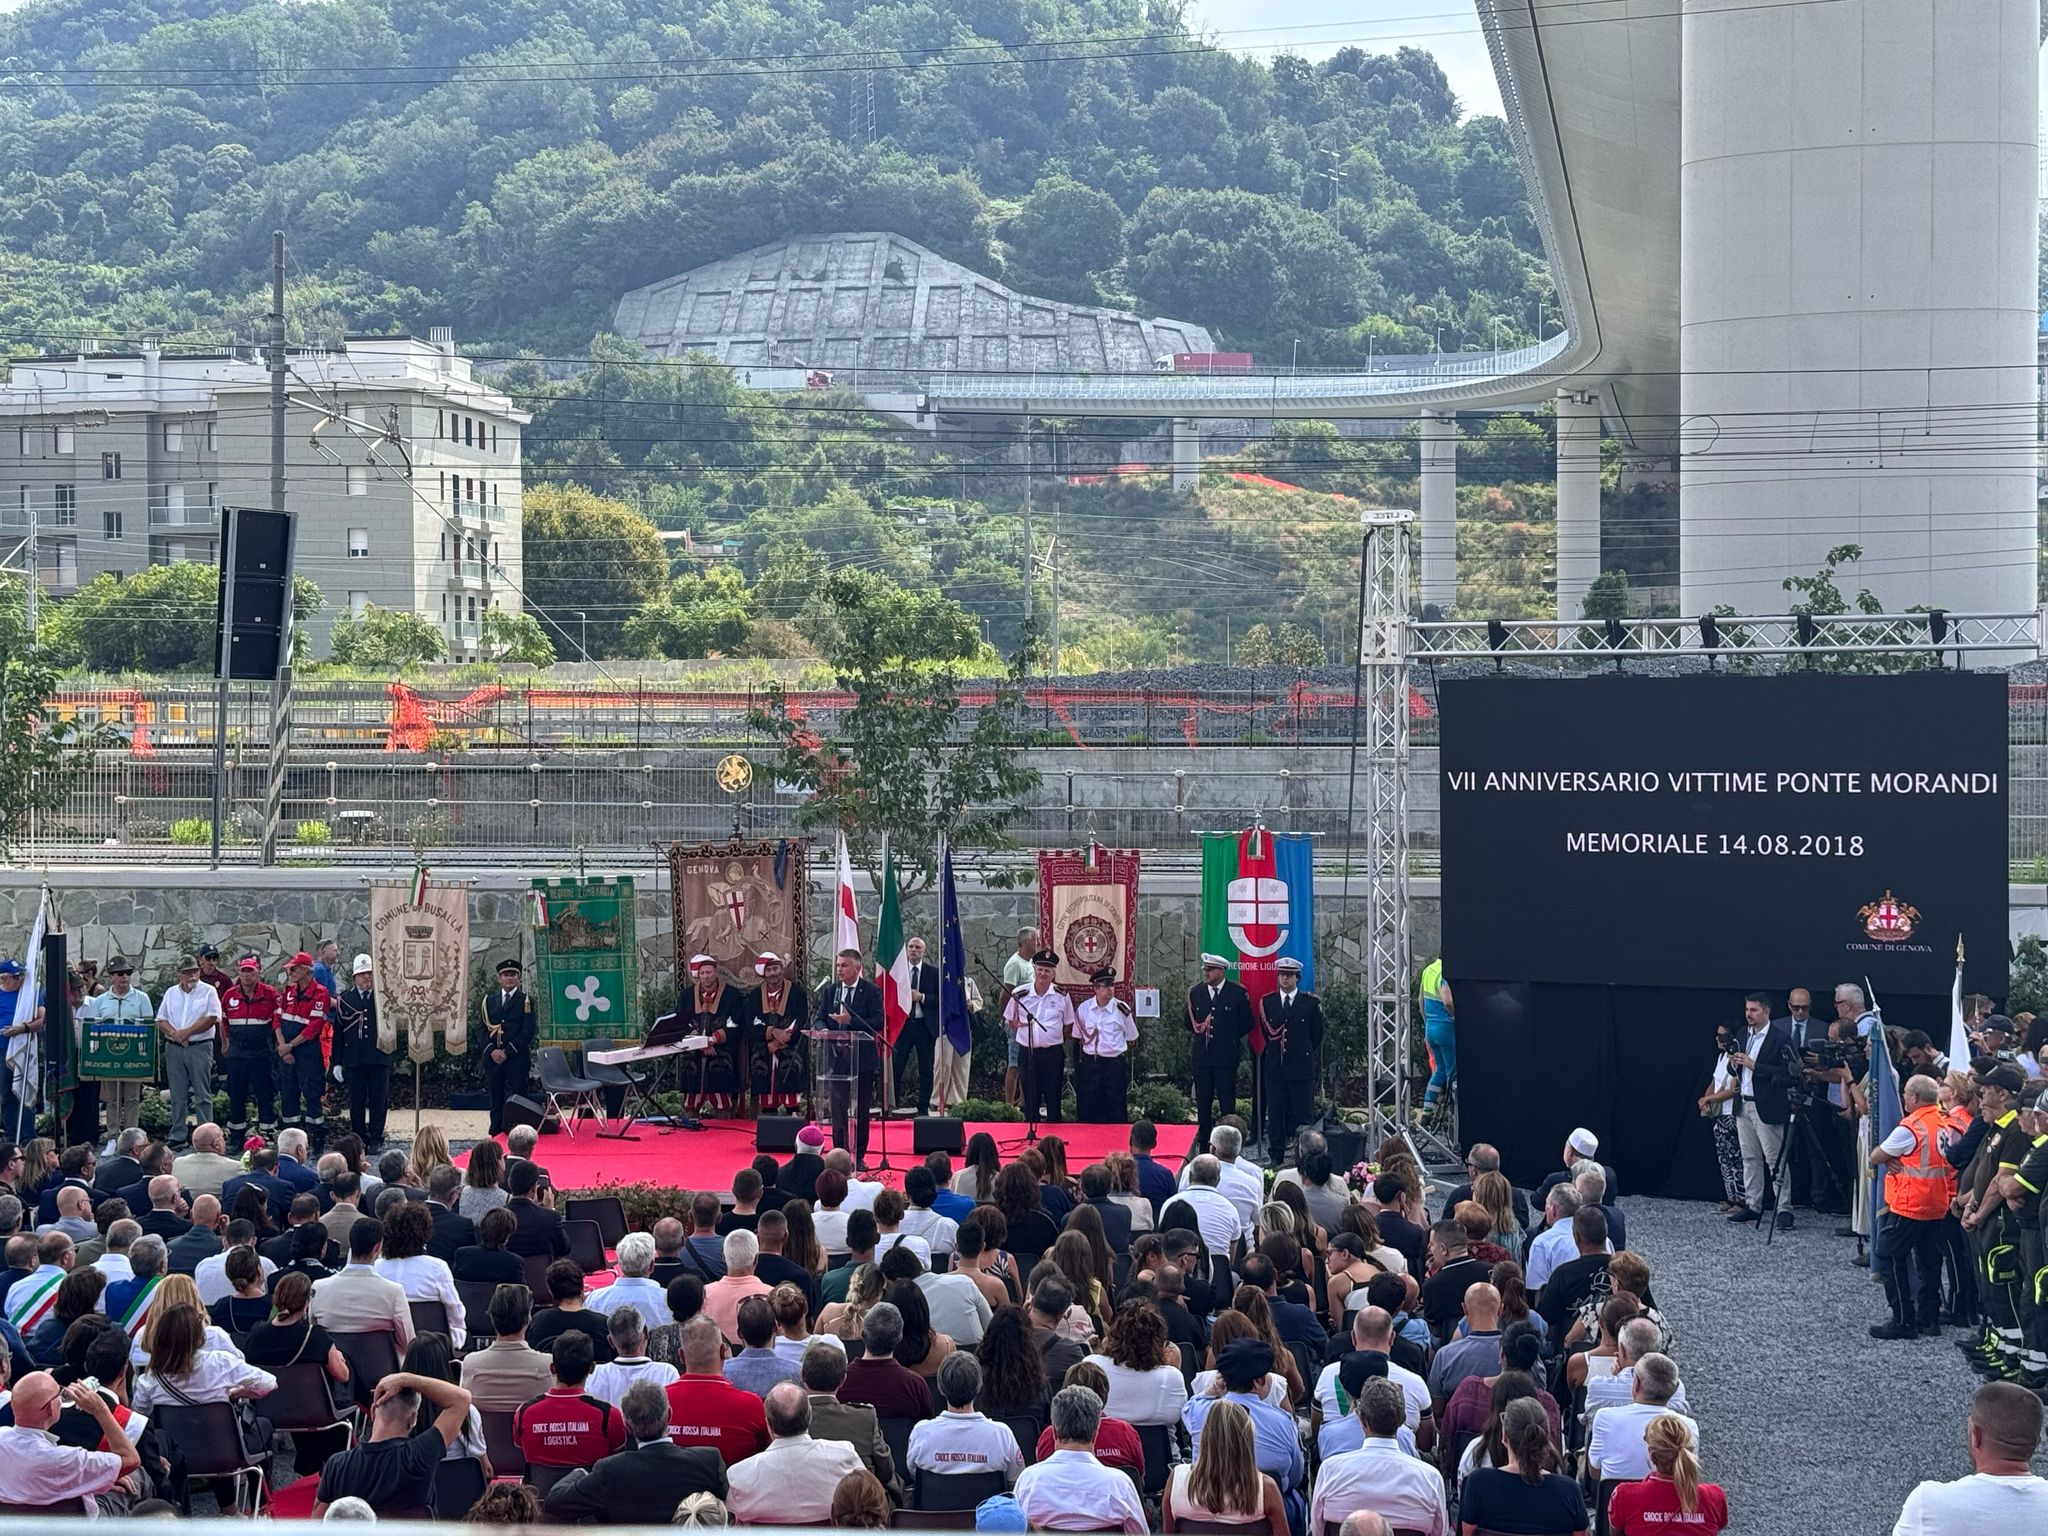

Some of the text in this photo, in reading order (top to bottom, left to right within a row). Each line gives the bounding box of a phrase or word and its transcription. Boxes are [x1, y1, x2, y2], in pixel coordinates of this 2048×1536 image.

[1447, 771, 1998, 793] VII ANNIVERSARIO VITTIME PONTE MORANDI
[1567, 833, 1865, 856] MEMORIALE 14.08.2018
[686, 865, 720, 874] GENOVA
[375, 903, 410, 931] COMUNE
[424, 902, 464, 934] BUSALLA
[1846, 943, 1933, 953] COMUNE DI GENOVA
[1228, 962, 1276, 971] REGIONE LIGU
[532, 1421, 590, 1433] CROCE ROSSA ITALIANA
[682, 1426, 699, 1436] ROSSA
[544, 1435, 578, 1446] LOGISTICA
[935, 1452, 988, 1464] CROCE ROSSA ITALIANA
[1643, 1512, 1663, 1522] CROCE
